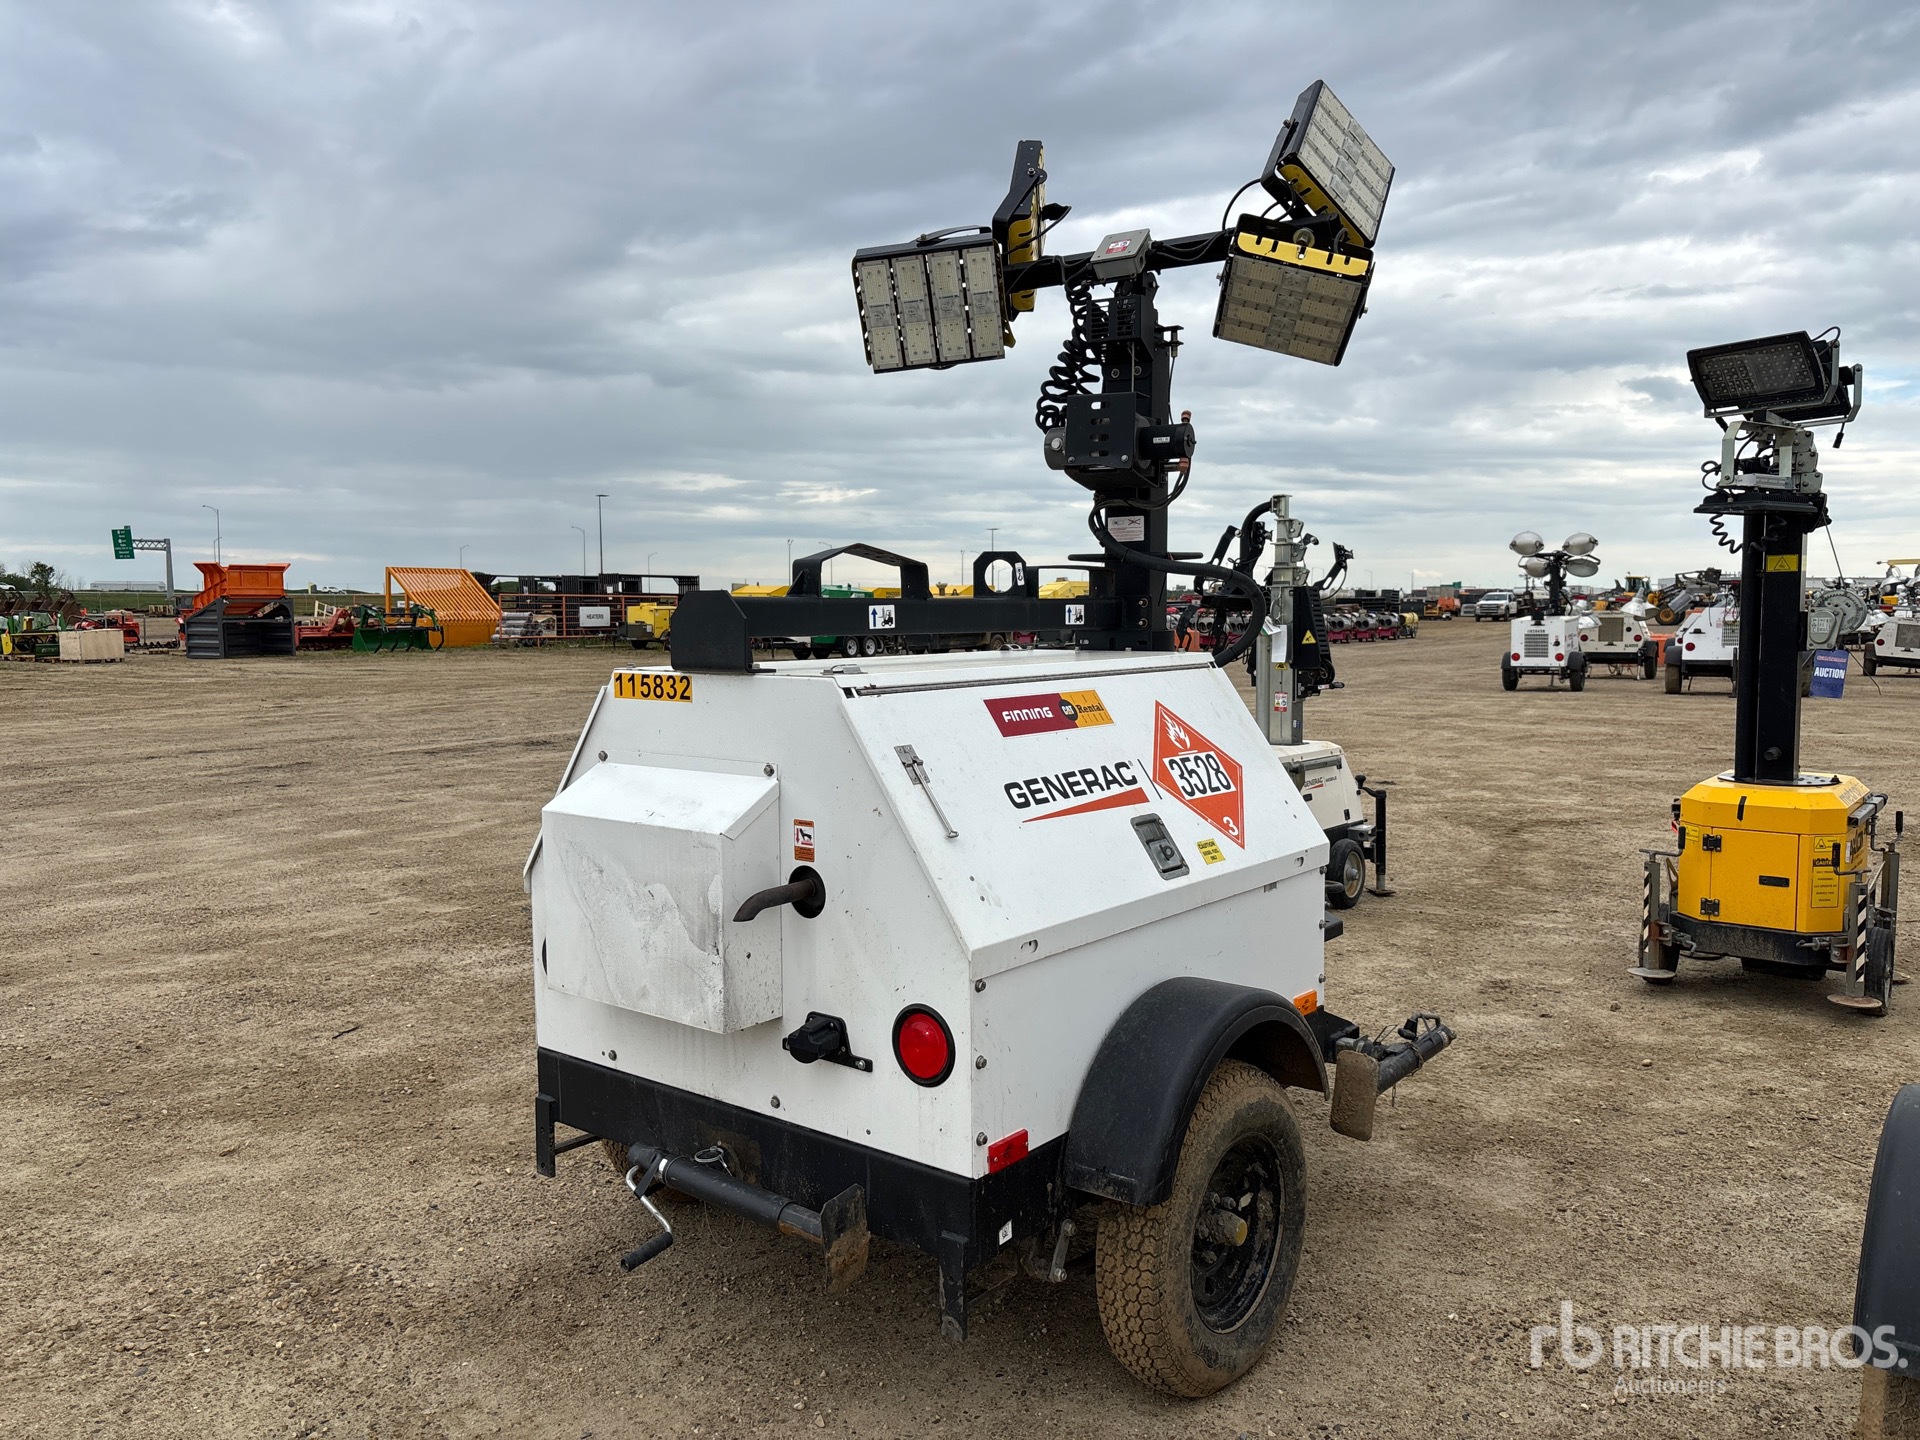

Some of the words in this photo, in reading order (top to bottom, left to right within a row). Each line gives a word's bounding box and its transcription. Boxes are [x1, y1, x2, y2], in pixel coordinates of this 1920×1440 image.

[1814, 667, 1845, 679] AUCTION
[615, 672, 691, 700] 115832
[1002, 706, 1054, 722] FINNING
[1061, 705, 1075, 715] CAT
[1075, 702, 1105, 713] Rental
[1003, 761, 1138, 809] GENERAC
[1169, 753, 1231, 798] 3528
[1222, 816, 1239, 836] 3
[1198, 841, 1215, 849] CAUTION
